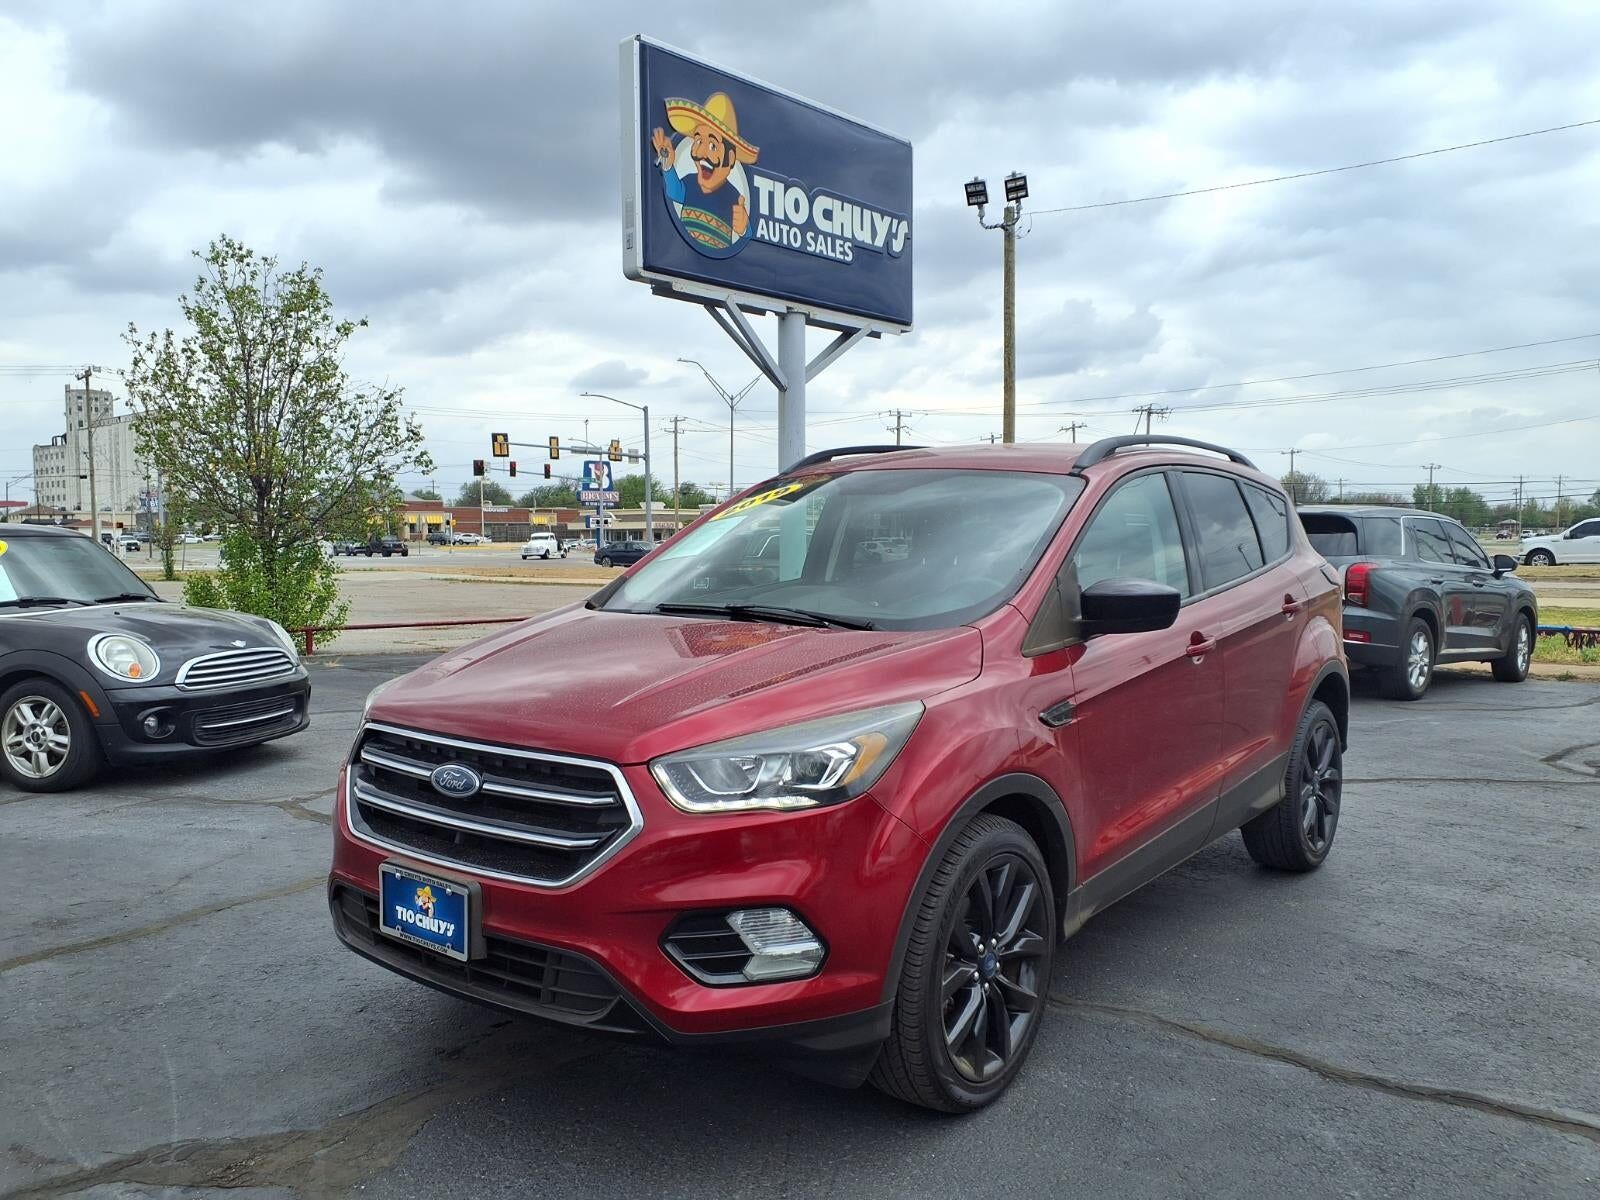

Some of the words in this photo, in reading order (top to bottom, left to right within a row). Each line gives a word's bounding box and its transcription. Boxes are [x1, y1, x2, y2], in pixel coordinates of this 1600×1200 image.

[754, 174, 809, 225] TIO
[813, 195, 909, 253] CHUY'S
[756, 219, 802, 248] AUTO
[806, 231, 853, 262] SALES
[440, 770, 467, 790] Ford
[395, 905, 415, 924] TIO
[415, 913, 455, 937] CHUY'S
